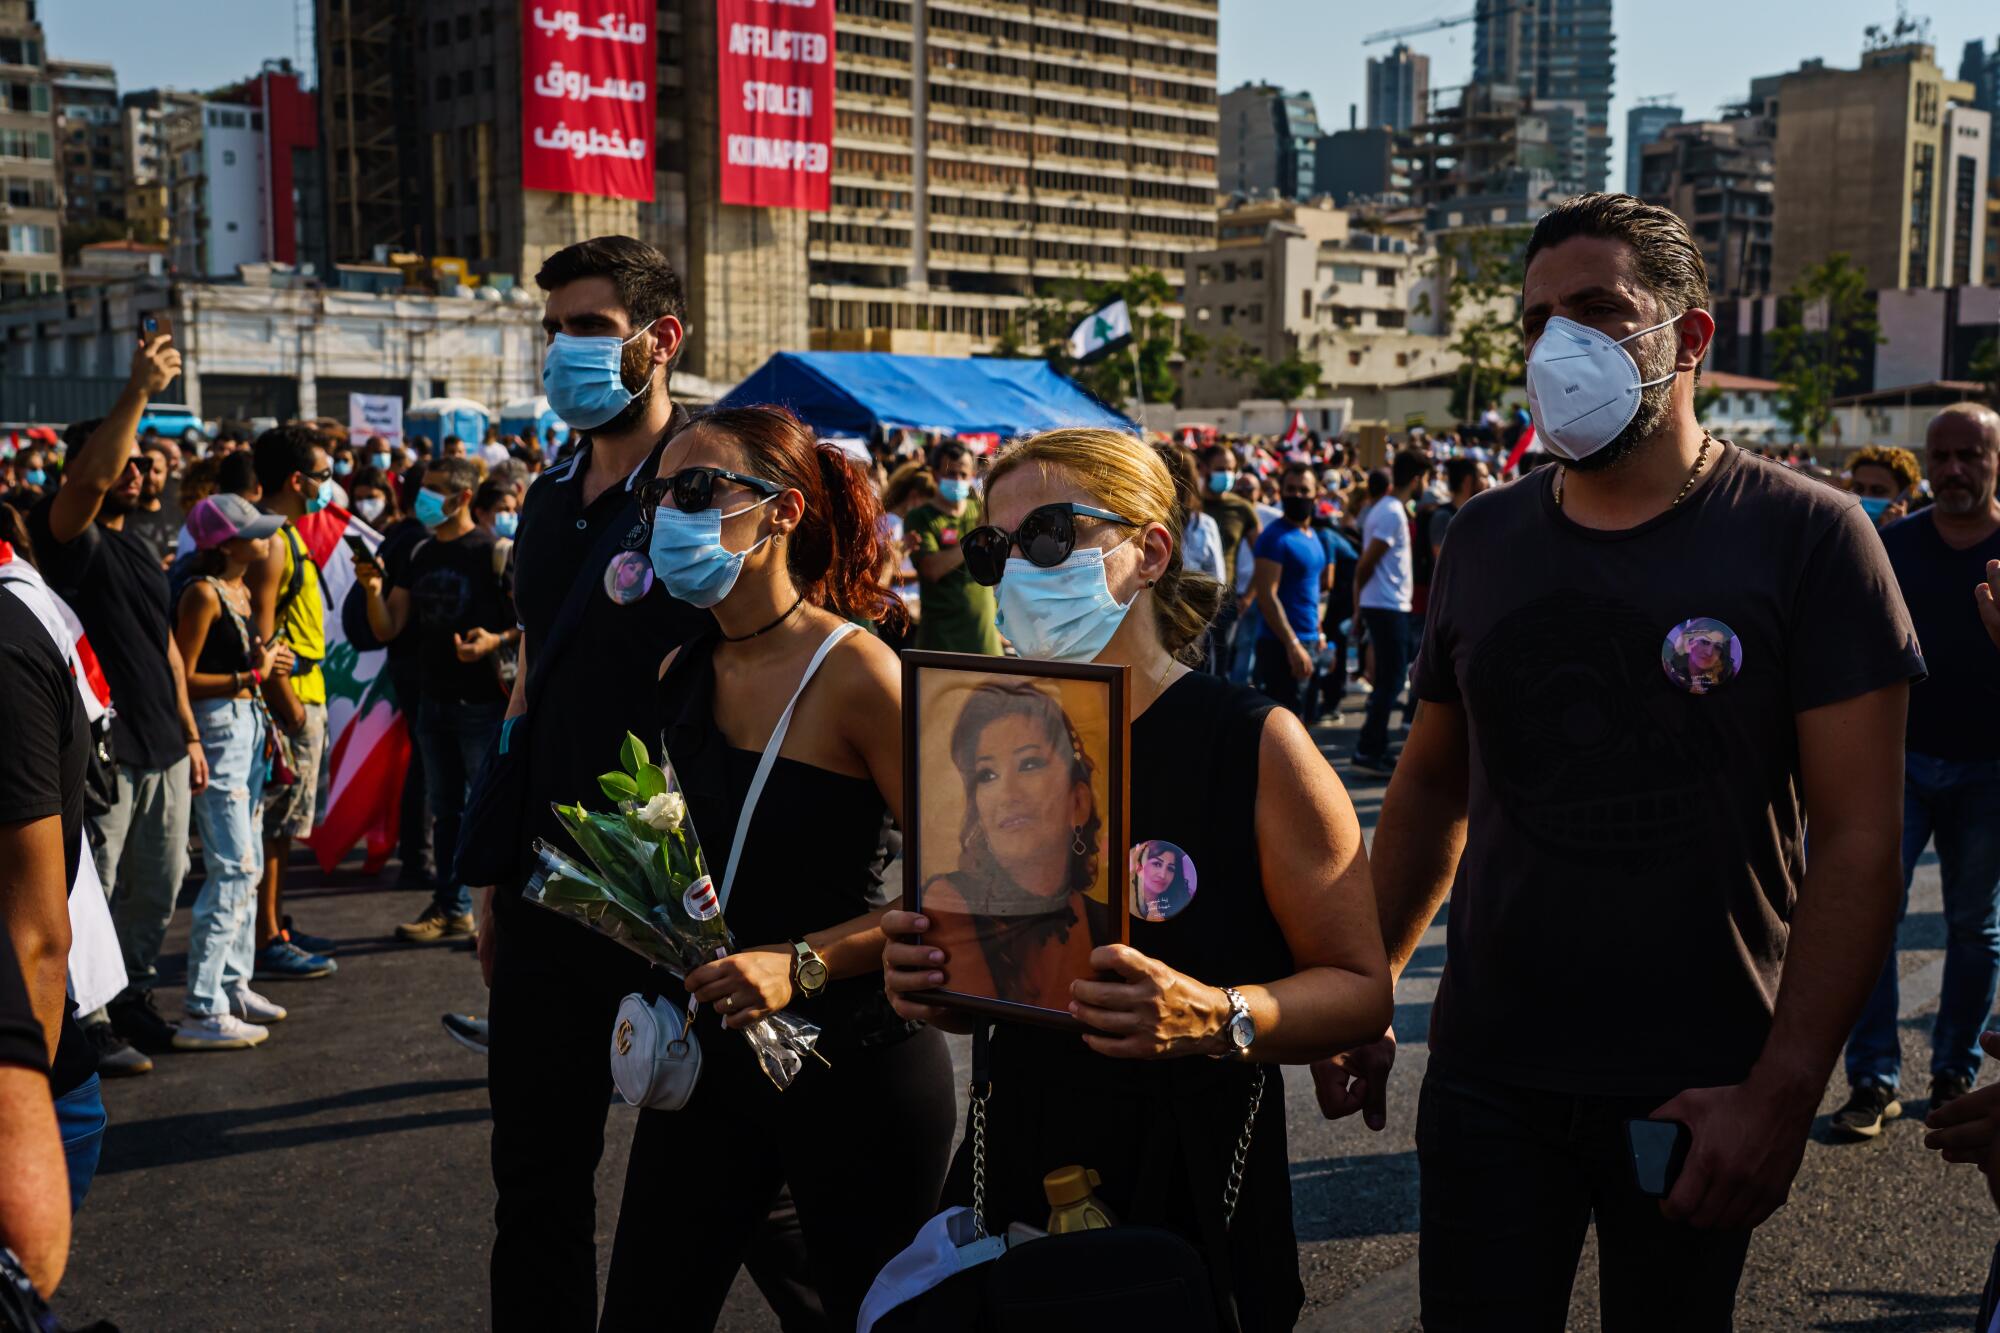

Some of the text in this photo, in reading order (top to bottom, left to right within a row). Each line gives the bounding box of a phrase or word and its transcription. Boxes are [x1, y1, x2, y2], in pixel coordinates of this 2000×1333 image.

[534, 7, 646, 44] منكوب
[729, 22, 827, 64] AFFLICTED
[534, 61, 646, 102] مسروق
[743, 80, 813, 117] STOLEN
[534, 121, 646, 160] مخطوف
[728, 134, 828, 173] KIDNAPPED
